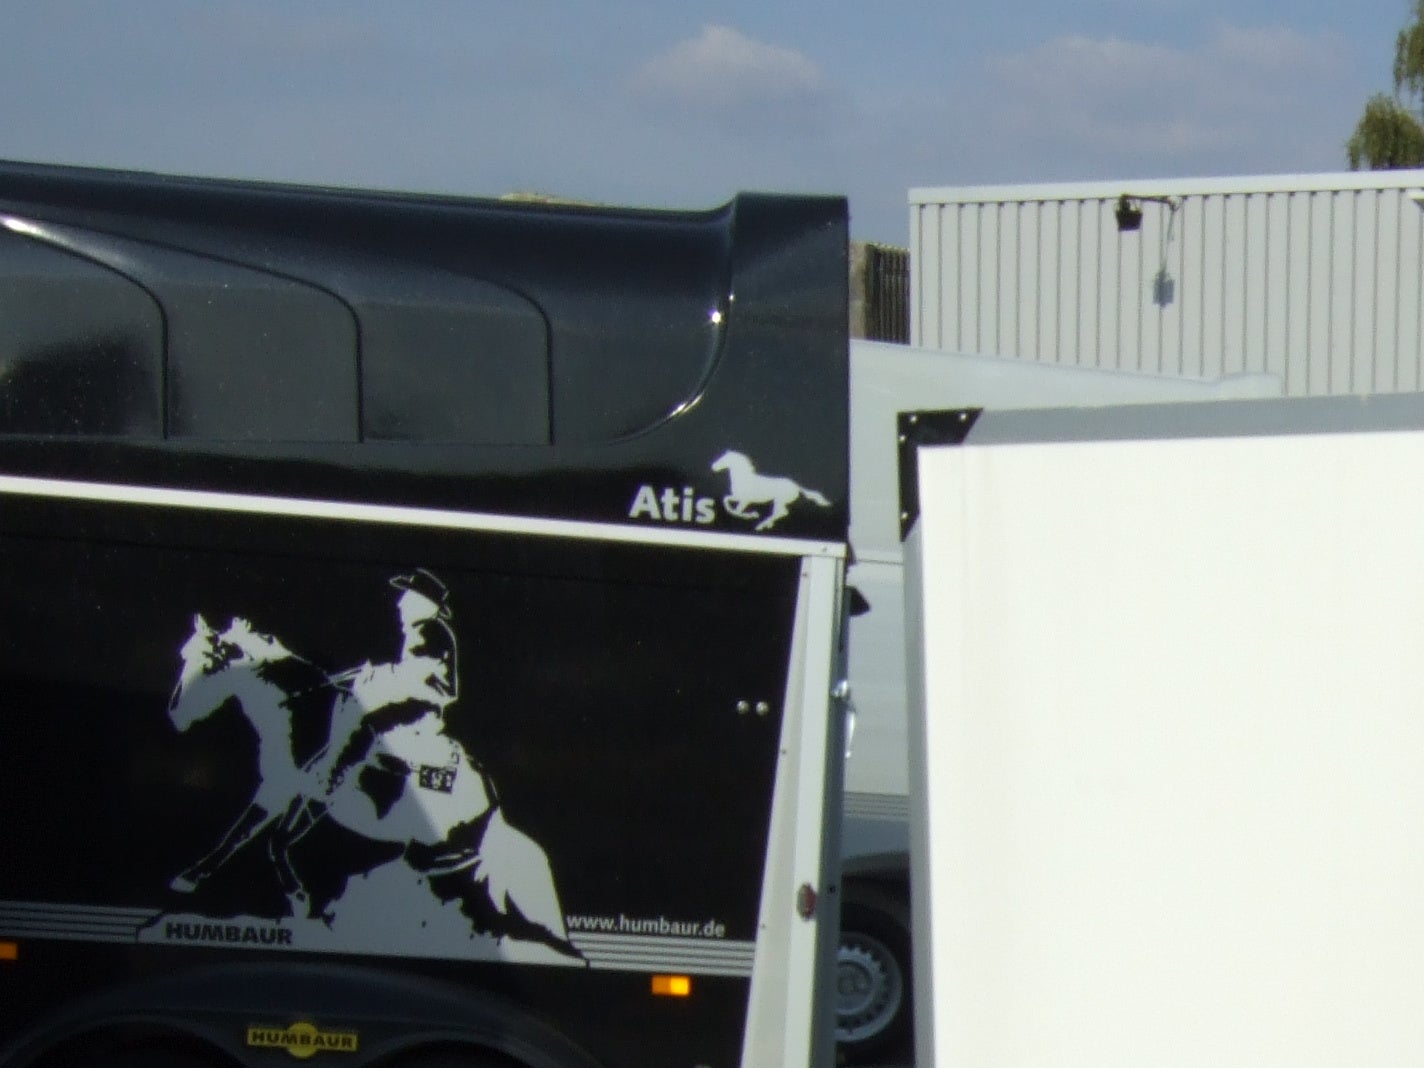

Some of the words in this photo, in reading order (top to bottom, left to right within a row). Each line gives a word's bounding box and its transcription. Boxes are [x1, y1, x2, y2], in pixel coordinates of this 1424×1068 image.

[628, 484, 716, 525] Atis
[165, 921, 293, 945] HUMBAUR
[566, 913, 727, 938] www.humbaur.de
[252, 1031, 353, 1048] HUMBAUR
